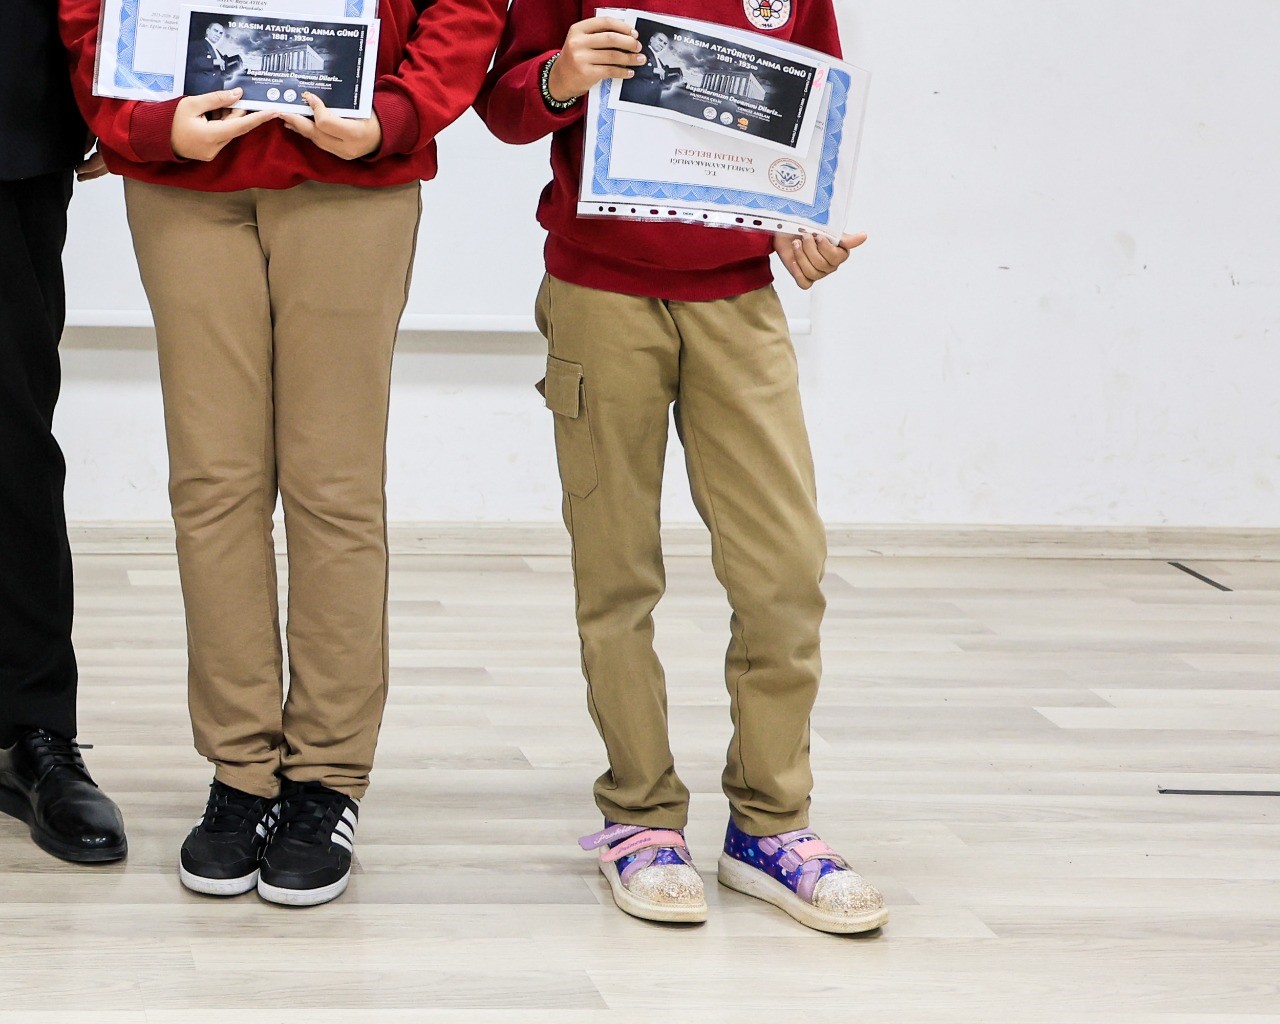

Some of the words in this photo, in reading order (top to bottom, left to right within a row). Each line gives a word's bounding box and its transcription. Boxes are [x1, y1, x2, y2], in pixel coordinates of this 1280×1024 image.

[238, 22, 264, 31] KASIM
[265, 25, 310, 34] ATATÜRK'Ü
[310, 28, 335, 36] ANMA
[336, 29, 360, 38] GÜNÜ
[272, 33, 288, 41] 1881
[673, 34, 682, 42] 10
[683, 37, 710, 49] KASIM
[710, 44, 756, 62] ATATÜRK'Ü
[756, 58, 781, 71] ANMA
[782, 66, 807, 78] GÜNÜ
[716, 54, 733, 64] 1881
[674, 148, 712, 158] BELGESİ
[713, 153, 753, 165] KATILIM
